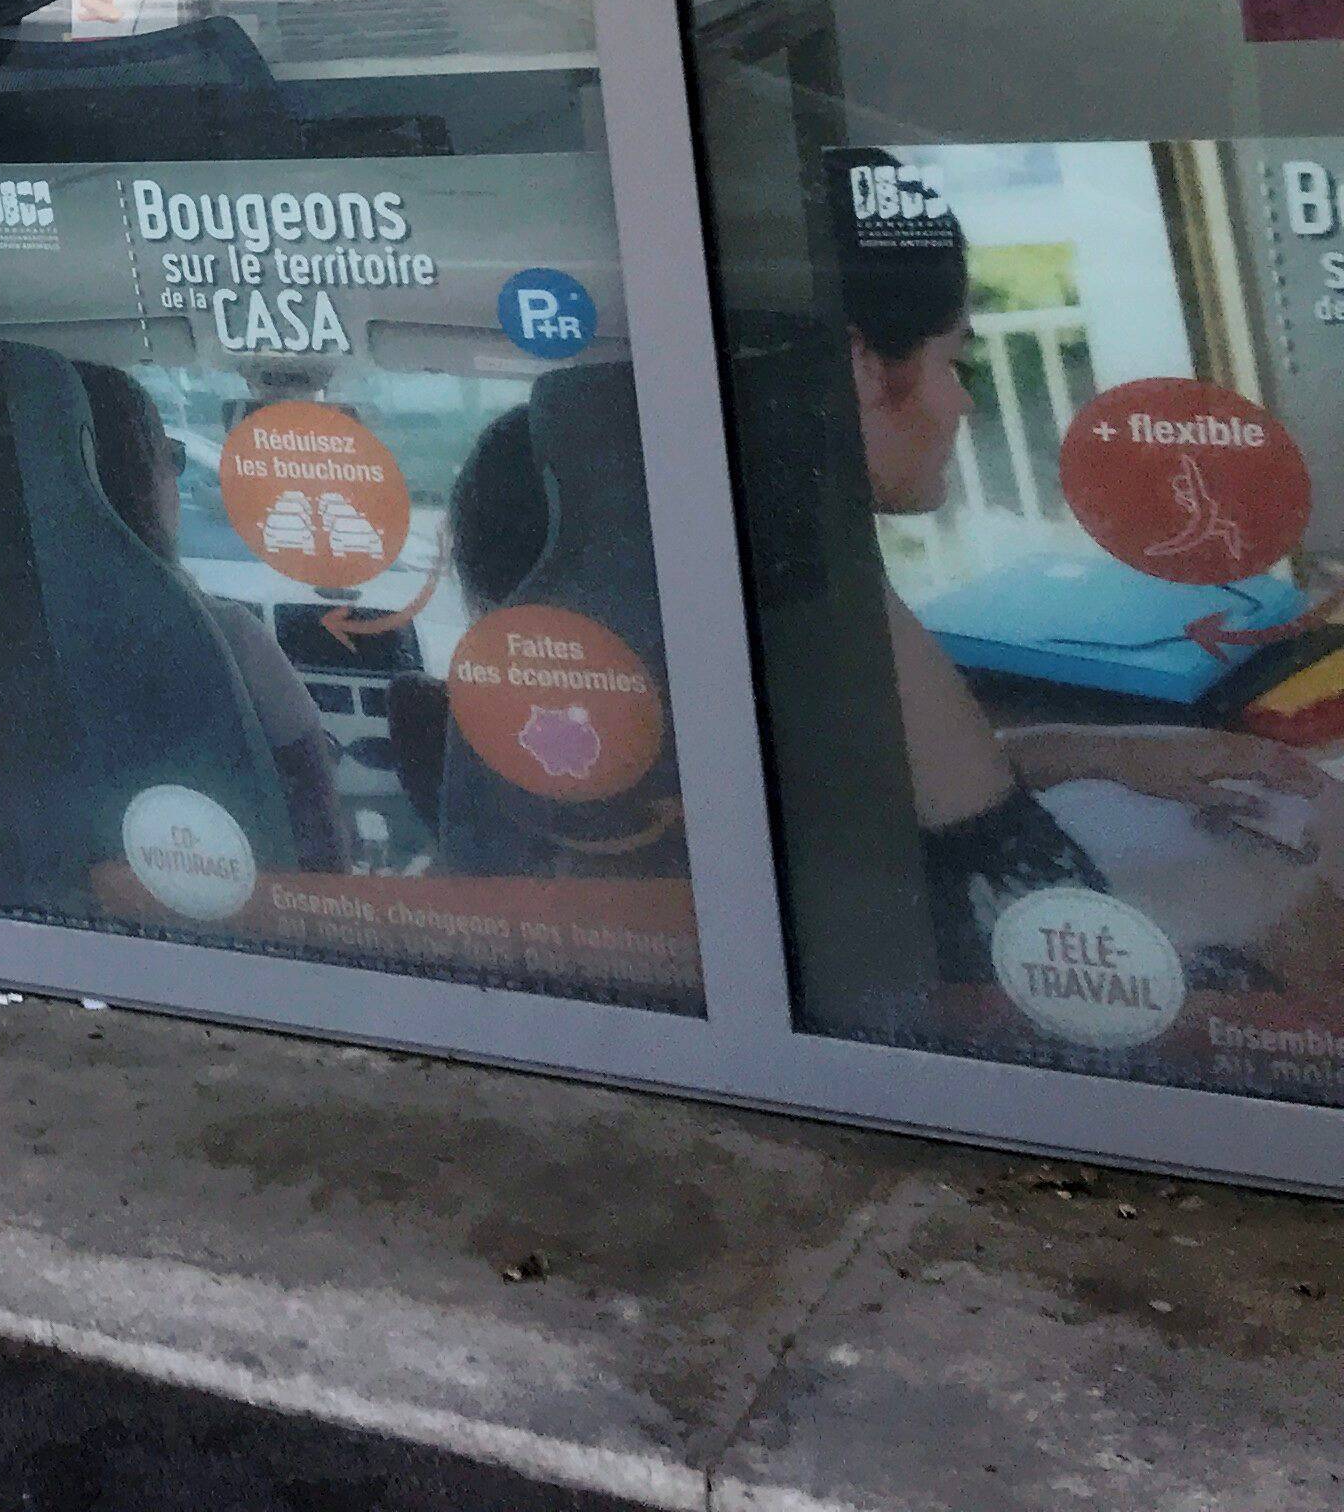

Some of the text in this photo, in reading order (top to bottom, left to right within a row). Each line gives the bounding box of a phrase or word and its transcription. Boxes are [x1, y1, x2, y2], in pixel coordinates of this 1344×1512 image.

[132, 179, 408, 253] Bougeons
[1282, 160, 1344, 235] B
[162, 244, 437, 286] sur le territoire
[162, 287, 351, 353] de la CASA
[252, 427, 356, 454] Réduisez
[1127, 412, 1266, 447] flexible
[234, 454, 385, 484] les bouchons
[507, 632, 585, 660] Faites
[457, 660, 648, 695] des économies
[139, 846, 242, 881] VOITURAGE
[387, 900, 510, 938] changeons
[1038, 921, 1129, 969] TÉLÉ-
[1021, 961, 1162, 1012] TRAVAIL
